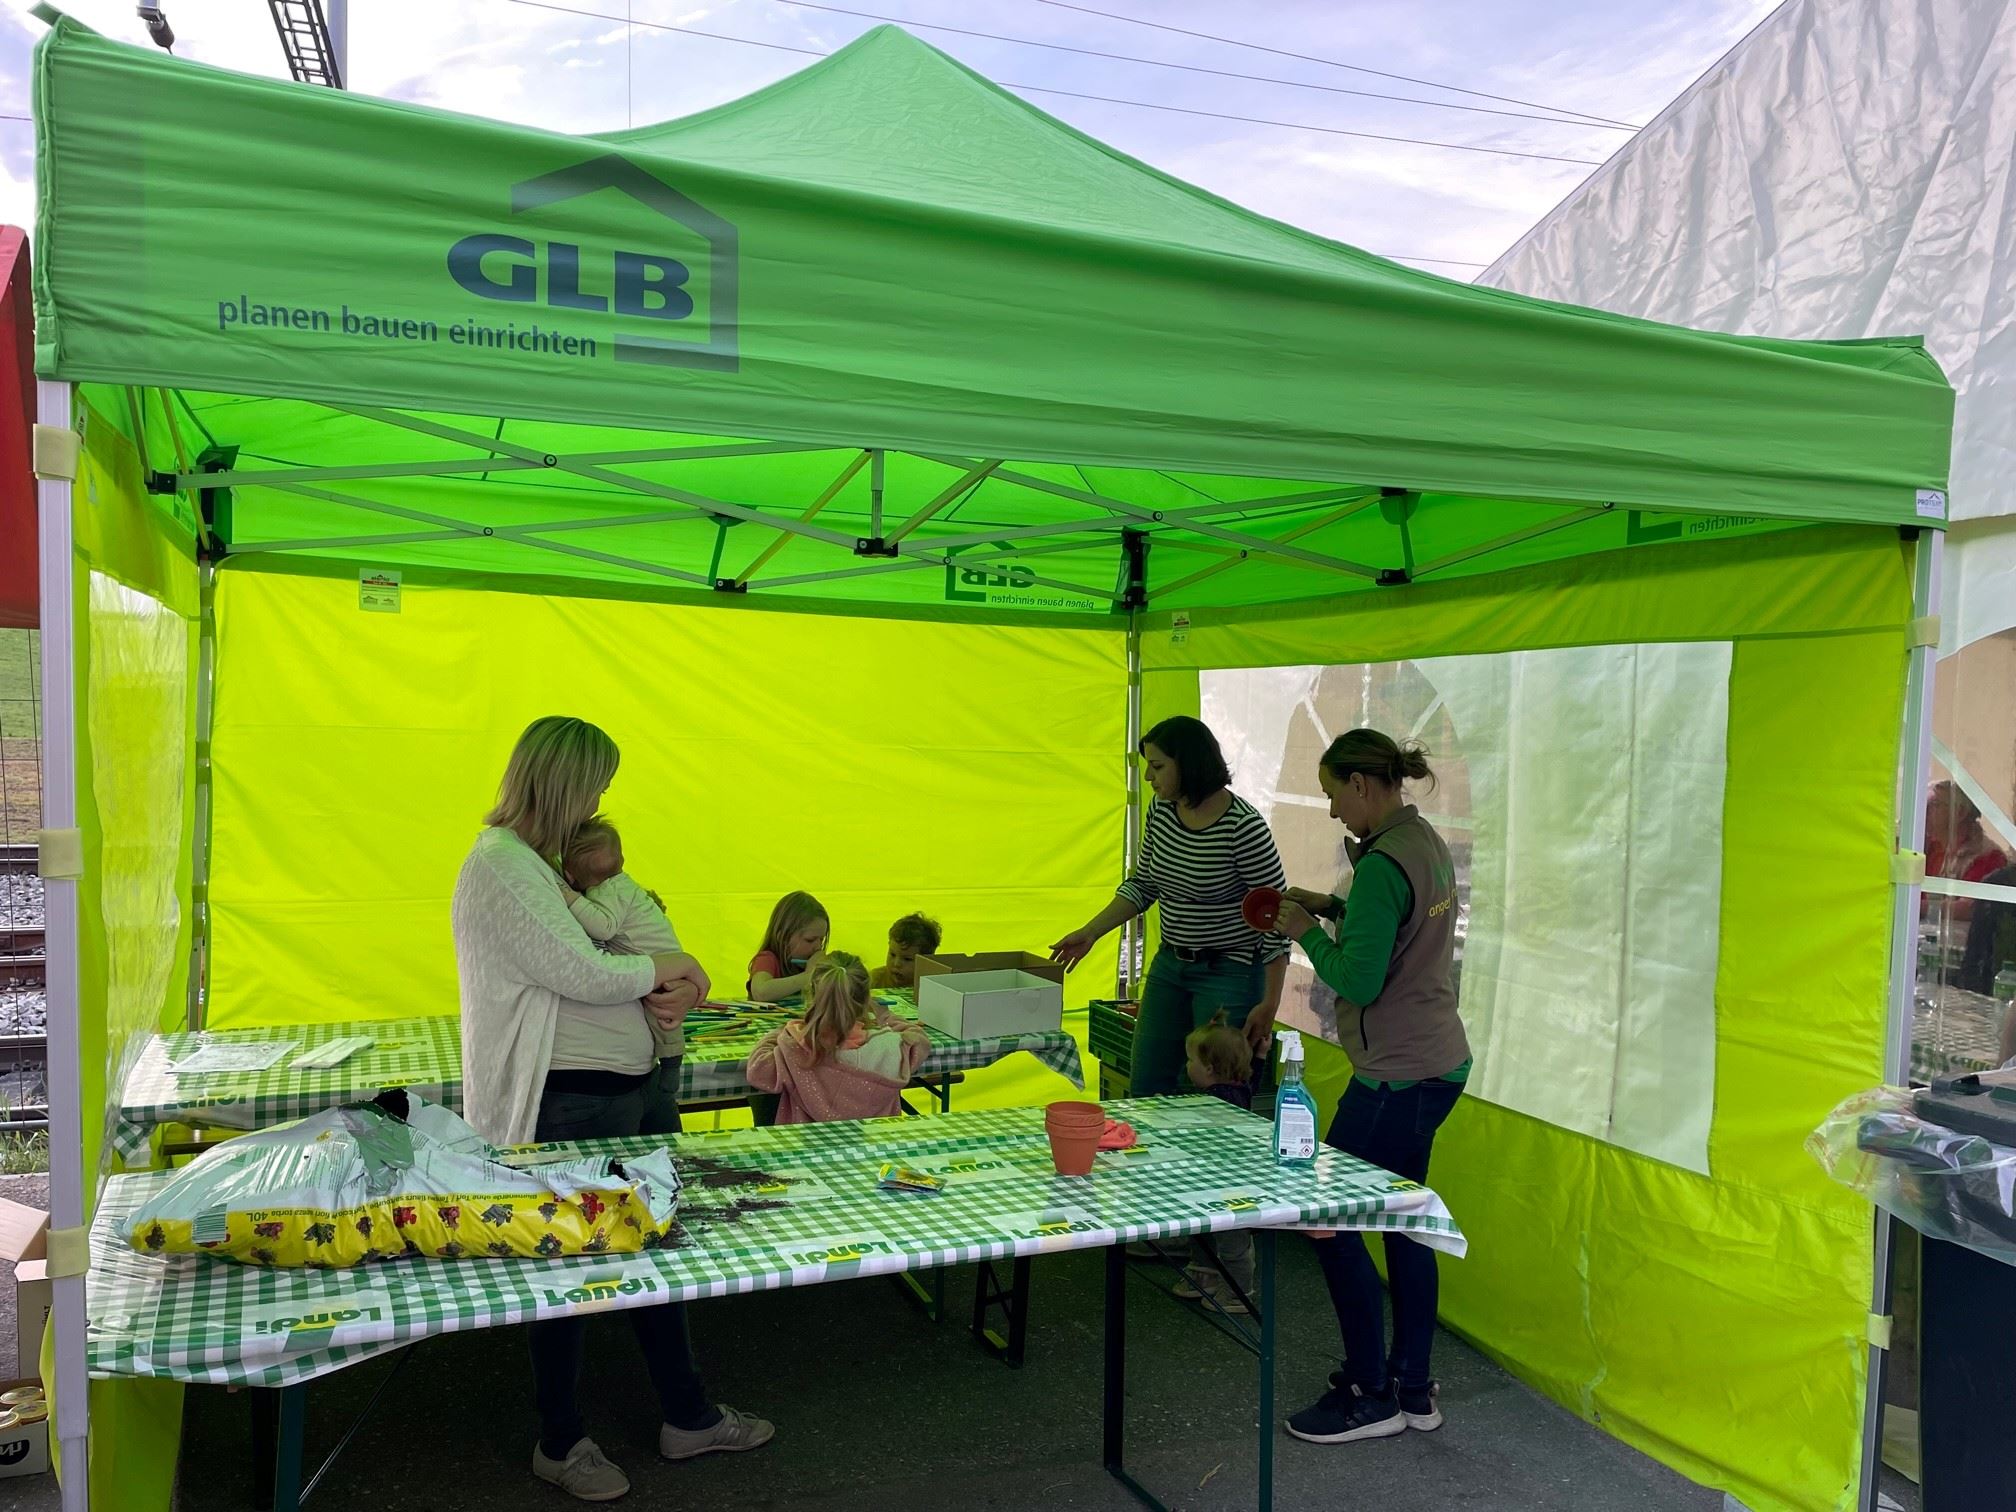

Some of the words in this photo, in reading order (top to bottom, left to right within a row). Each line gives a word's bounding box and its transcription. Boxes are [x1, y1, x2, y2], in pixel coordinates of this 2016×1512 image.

[447, 233, 694, 320] GLB
[218, 295, 331, 331] planen
[342, 305, 438, 343] bauen
[449, 318, 597, 358] einrichten
[924, 1160, 1006, 1176] Landi
[271, 1209, 293, 1217] torba
[1196, 1195, 1282, 1213] Landi
[246, 1212, 269, 1222] 40L
[1010, 1220, 1104, 1240] Landi
[791, 1241, 895, 1266] Landi
[543, 1276, 657, 1308] Landi
[254, 1305, 383, 1336] Landi
